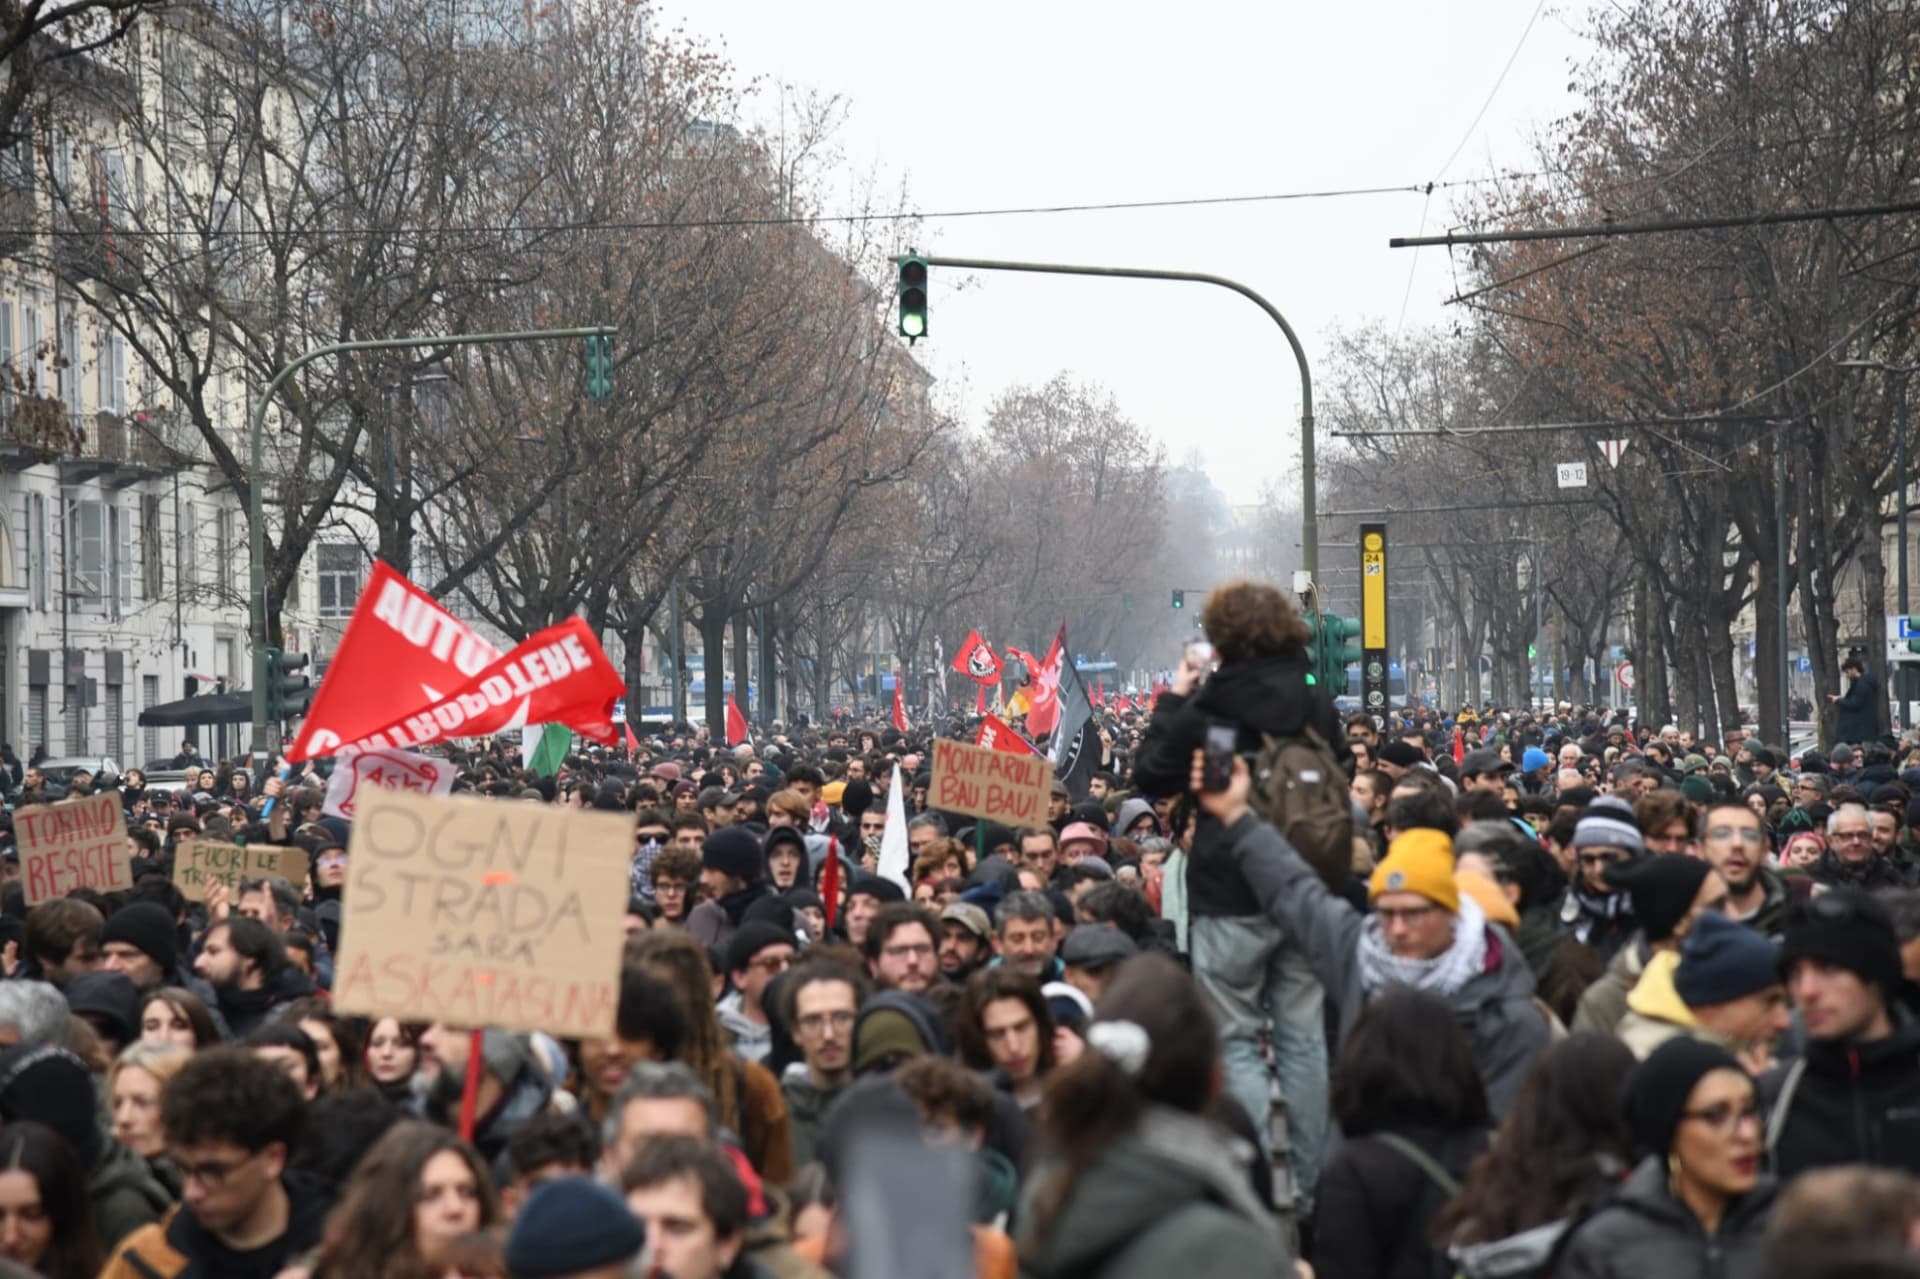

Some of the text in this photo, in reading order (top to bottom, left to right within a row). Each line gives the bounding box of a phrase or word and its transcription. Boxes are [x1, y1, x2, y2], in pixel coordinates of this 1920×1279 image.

[16, 798, 116, 848] TORINO
[940, 775, 1038, 821] BAU BAU!
[27, 841, 123, 902] RESISTE
[192, 843, 279, 871] FUORI LE
[363, 803, 570, 881] OGNI
[352, 865, 590, 943] STRADA
[343, 951, 615, 1030] ASKATASUNA
